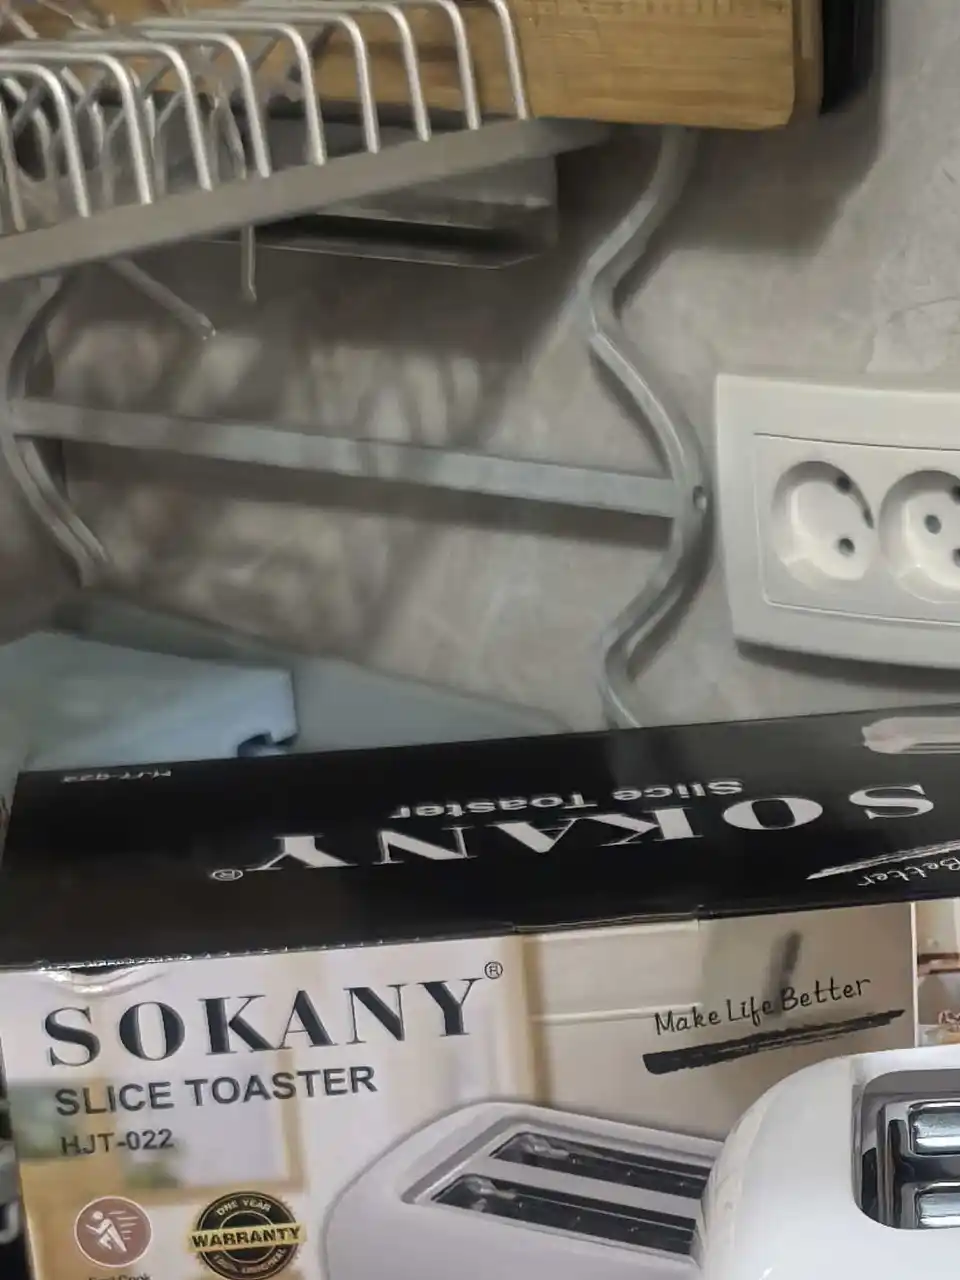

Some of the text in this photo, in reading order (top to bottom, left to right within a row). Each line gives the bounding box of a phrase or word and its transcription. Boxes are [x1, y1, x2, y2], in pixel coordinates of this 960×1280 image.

[389, 781, 744, 819] Slice Toaster
[654, 976, 872, 1036] Make Life Better
[56, 1066, 378, 1117] SLICE TOASTER
[60, 1128, 175, 1156] HJT-022
[191, 1226, 302, 1248] WARRANTY
